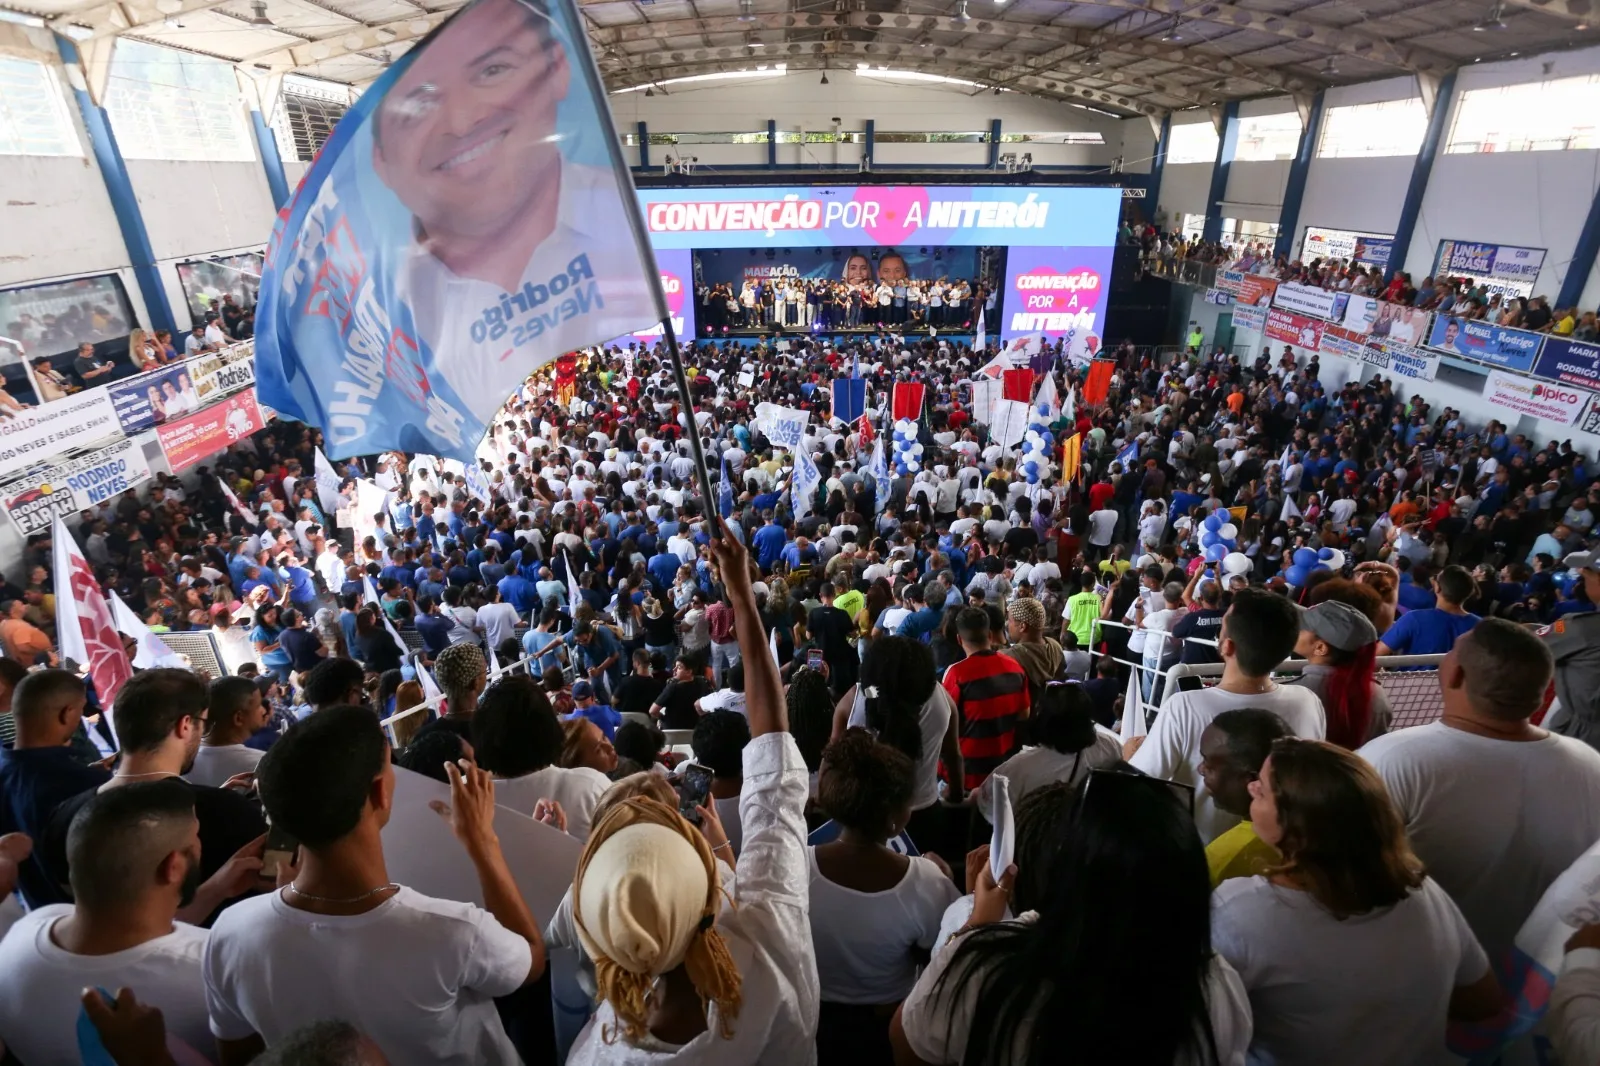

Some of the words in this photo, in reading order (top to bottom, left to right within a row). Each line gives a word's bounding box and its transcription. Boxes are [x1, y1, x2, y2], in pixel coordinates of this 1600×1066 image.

[650, 194, 820, 237] CONVENÇÃO
[824, 201, 880, 228] POR
[902, 201, 923, 228] A
[926, 192, 1050, 228] NITERÓI
[1451, 256, 1489, 271] BRASIL
[1017, 272, 1098, 293] CONVENÇÃO
[1028, 295, 1054, 308] POR
[1068, 294, 1078, 307] A
[1011, 306, 1096, 330] NITERÓI
[1498, 331, 1534, 349] Rodrigo
[1497, 342, 1527, 358] Neves
[1568, 346, 1598, 359] MARIA
[1391, 352, 1427, 369] RODRIGO
[1394, 362, 1418, 378] NEVES
[1556, 362, 1598, 378] RODRIGO
[216, 365, 250, 390] Rodrigo
[2, 418, 36, 436] GALLO
[15, 437, 46, 454] NEVES
[48, 434, 55, 443] E
[57, 424, 85, 440] ISABEL
[87, 415, 109, 429] SWAN
[5, 480, 25, 494] QUE
[42, 467, 65, 480] BOM
[65, 461, 80, 473] VAI
[83, 454, 100, 465] SER
[101, 440, 132, 457] MELHOR
[67, 459, 126, 492] RODRIGO
[87, 475, 128, 504] NEVES
[10, 489, 71, 520] RODRIGO
